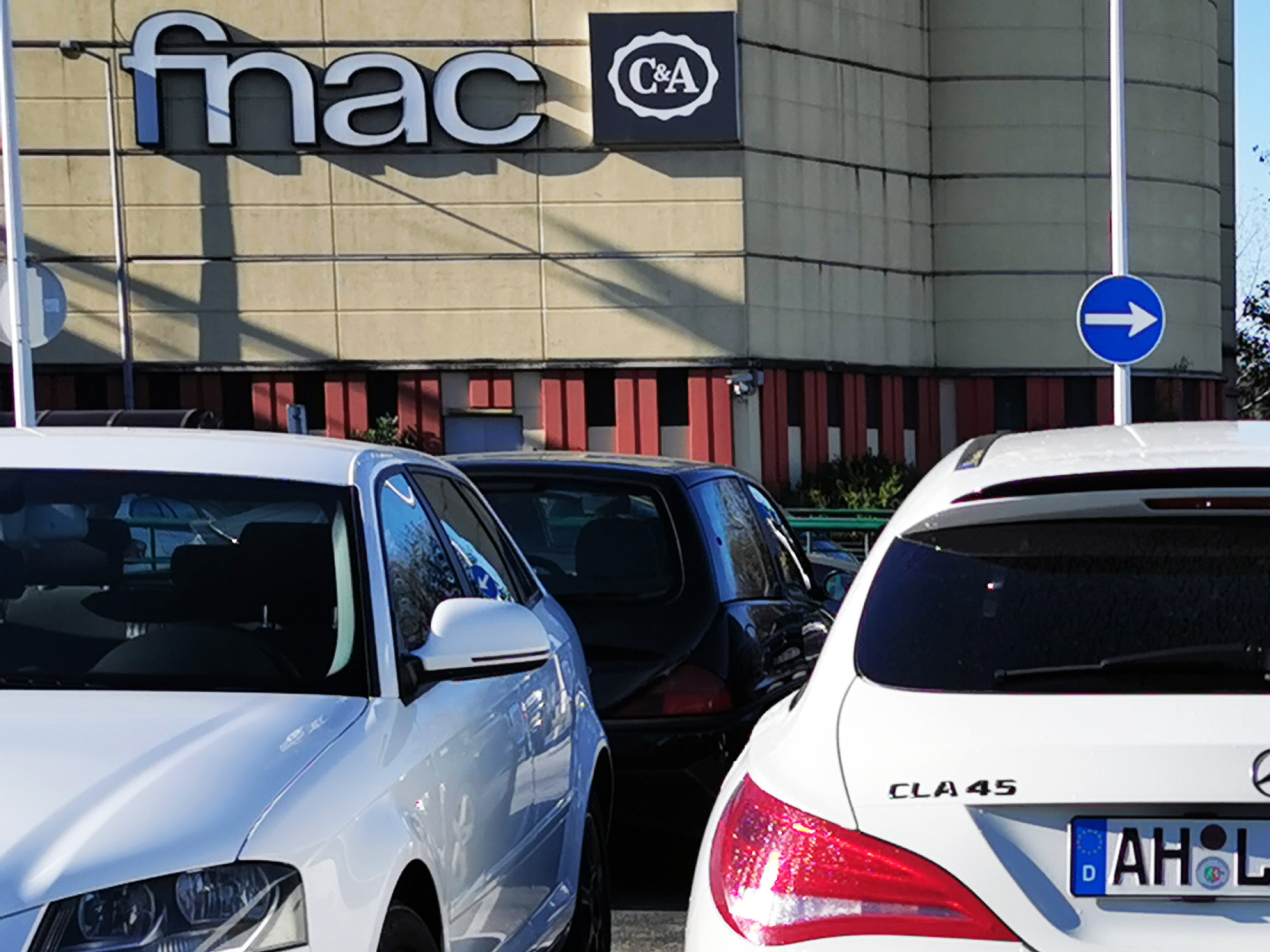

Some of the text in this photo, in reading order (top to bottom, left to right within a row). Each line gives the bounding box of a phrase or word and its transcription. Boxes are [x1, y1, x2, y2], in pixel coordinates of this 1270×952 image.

[120, 10, 545, 148] fnac
[629, 56, 700, 95] C&A
[889, 779, 1017, 799] CLA 45
[1082, 864, 1096, 882] D
[1112, 827, 1191, 886] AH
